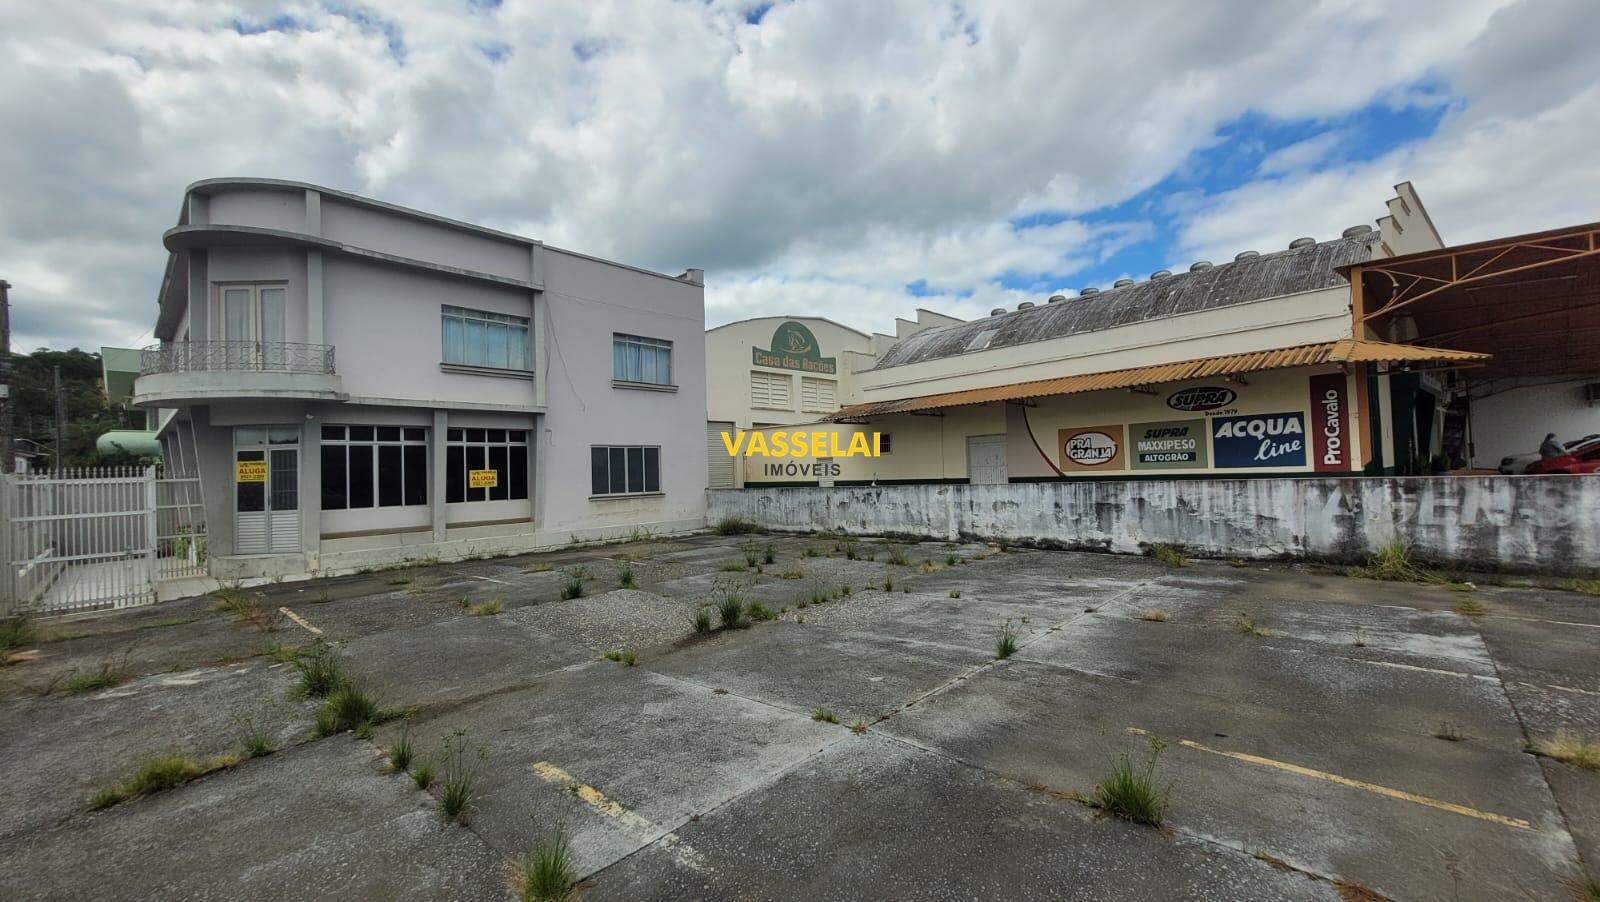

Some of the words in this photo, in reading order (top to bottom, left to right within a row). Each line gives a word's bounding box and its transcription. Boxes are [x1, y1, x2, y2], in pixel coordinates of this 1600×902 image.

[783, 355, 801, 369] das
[1173, 389, 1228, 407] SUPRA
[1144, 427, 1190, 439] SUPRA
[1214, 417, 1303, 440] ACQUA
[1321, 389, 1342, 465] ProCavalo
[1070, 438, 1092, 449] PRA
[1137, 439, 1196, 452] MAXXIPESO
[1253, 439, 1302, 461] line
[1070, 447, 1113, 459] GRANJA
